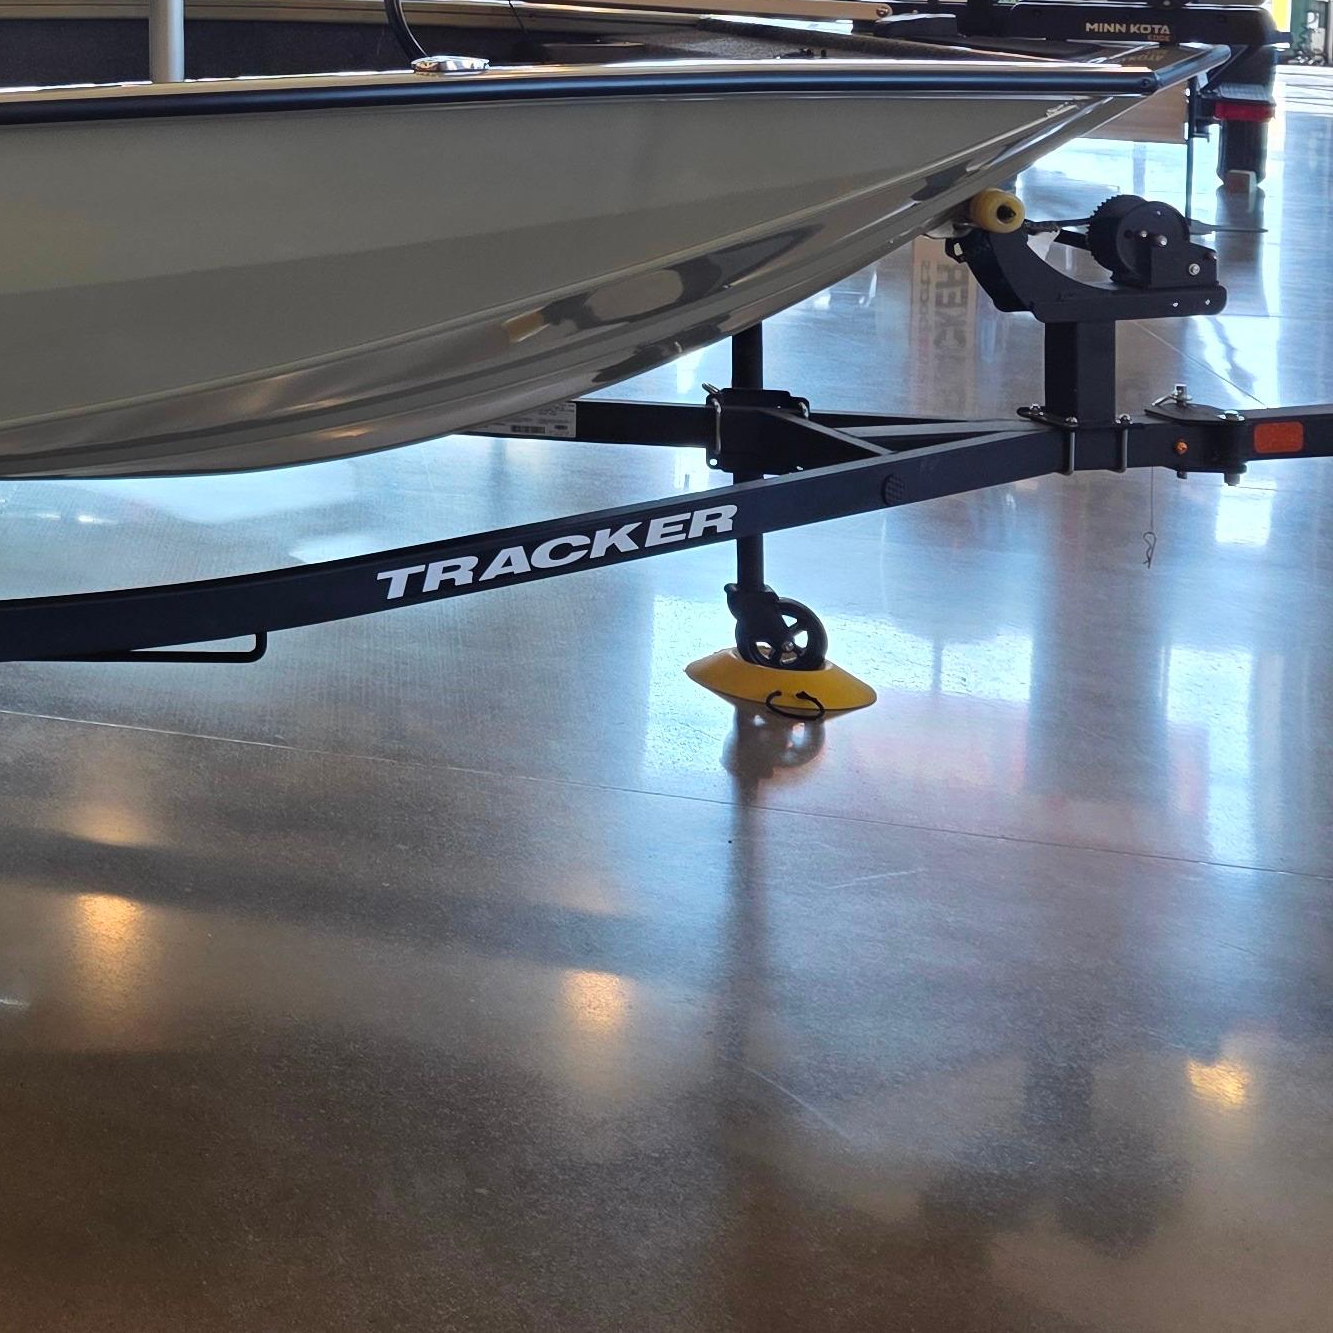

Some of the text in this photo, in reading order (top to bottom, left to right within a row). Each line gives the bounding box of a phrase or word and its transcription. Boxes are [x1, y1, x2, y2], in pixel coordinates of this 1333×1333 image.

[1085, 22, 1170, 34] MINN KOTA
[377, 504, 737, 600] TRACKER
